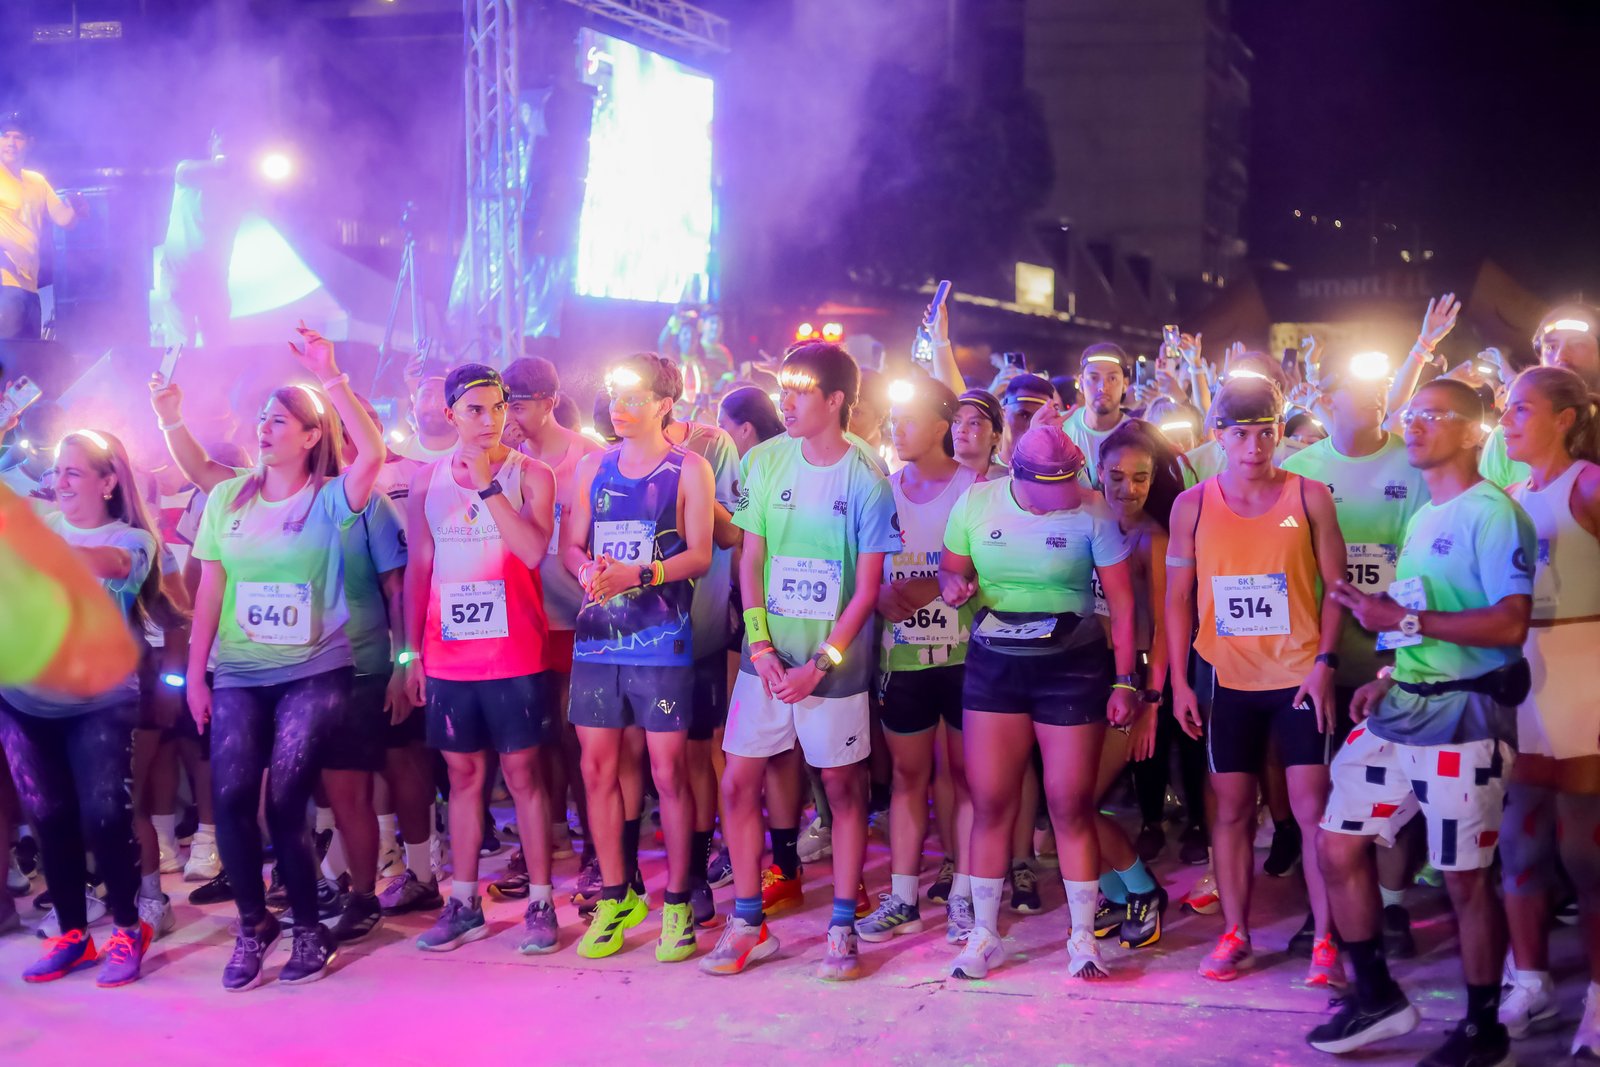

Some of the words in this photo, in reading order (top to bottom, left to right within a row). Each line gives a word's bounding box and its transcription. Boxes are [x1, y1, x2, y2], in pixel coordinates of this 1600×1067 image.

[474, 527, 482, 536] &
[602, 541, 641, 560] 503
[782, 578, 827, 602] 509
[248, 604, 298, 626] 640
[452, 602, 494, 624] 527
[1229, 597, 1272, 618] 514
